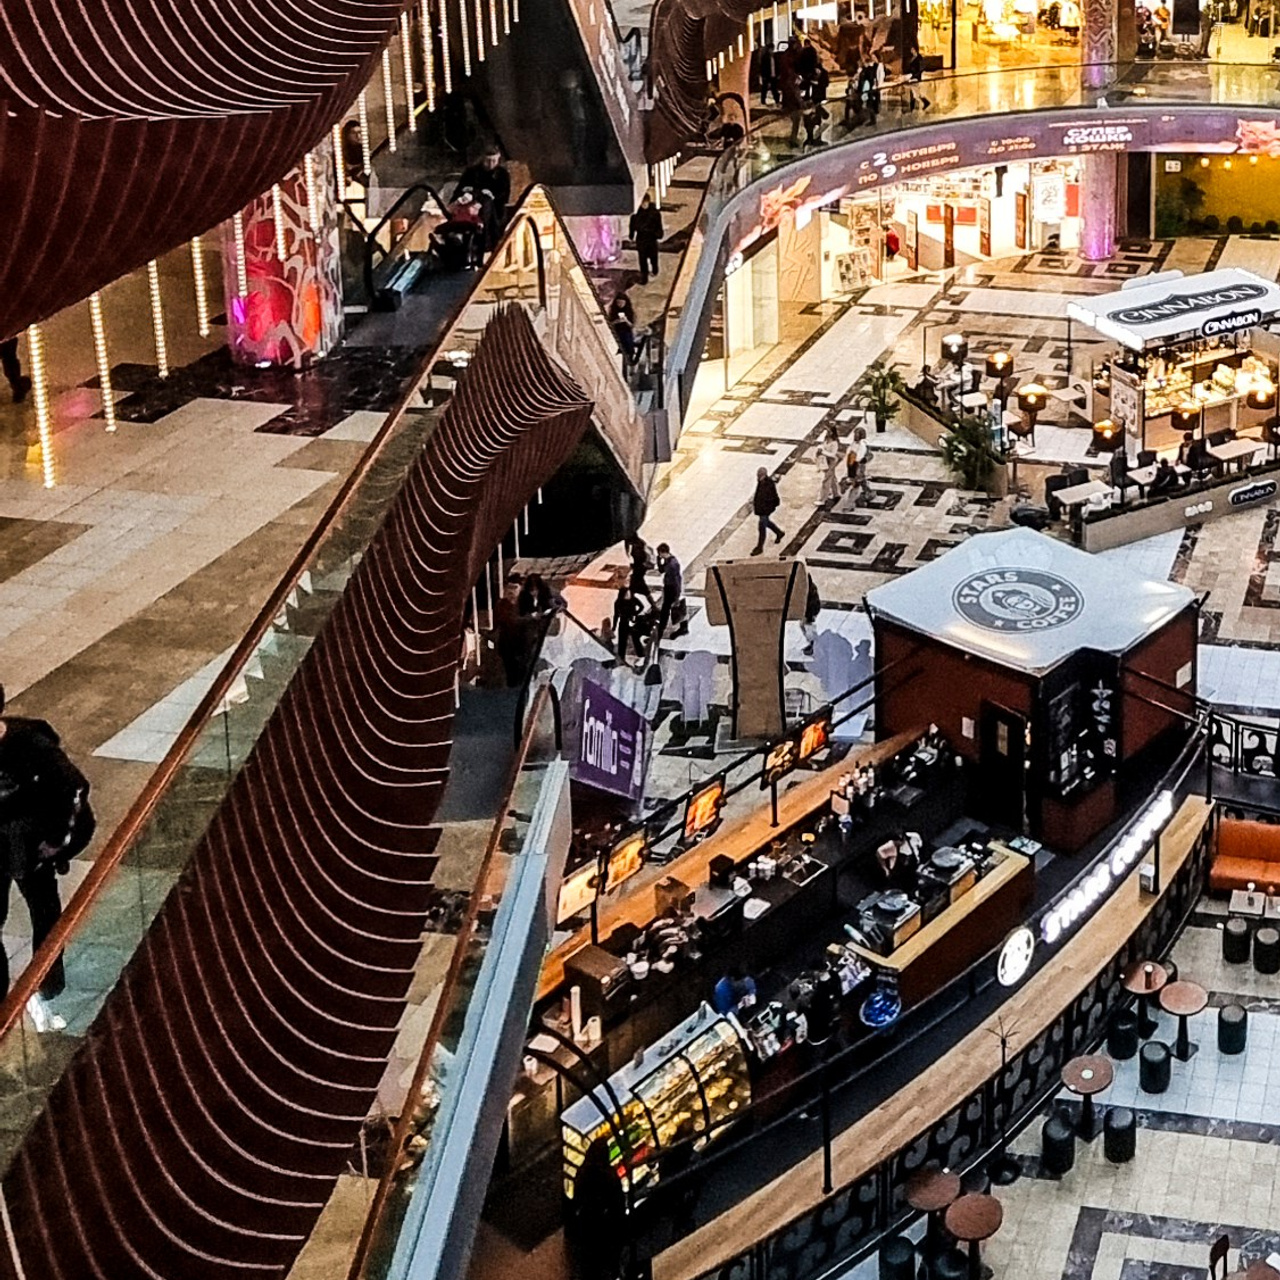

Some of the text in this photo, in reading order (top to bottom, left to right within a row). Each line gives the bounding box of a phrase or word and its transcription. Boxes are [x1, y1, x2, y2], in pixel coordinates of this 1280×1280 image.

[1063, 133, 1132, 145] КОШКИ
[1067, 126, 1129, 137] СУПЕР
[873, 152, 888, 167] 2
[891, 142, 957, 162] ОКТЯБРЯ
[881, 164, 897, 178] 9
[900, 155, 960, 174] НОЯБРЯ
[1118, 286, 1258, 322] CINNABON
[1204, 312, 1260, 335] CINNABON
[960, 571, 1018, 604] STARS
[1017, 596, 1076, 629] COFFEE
